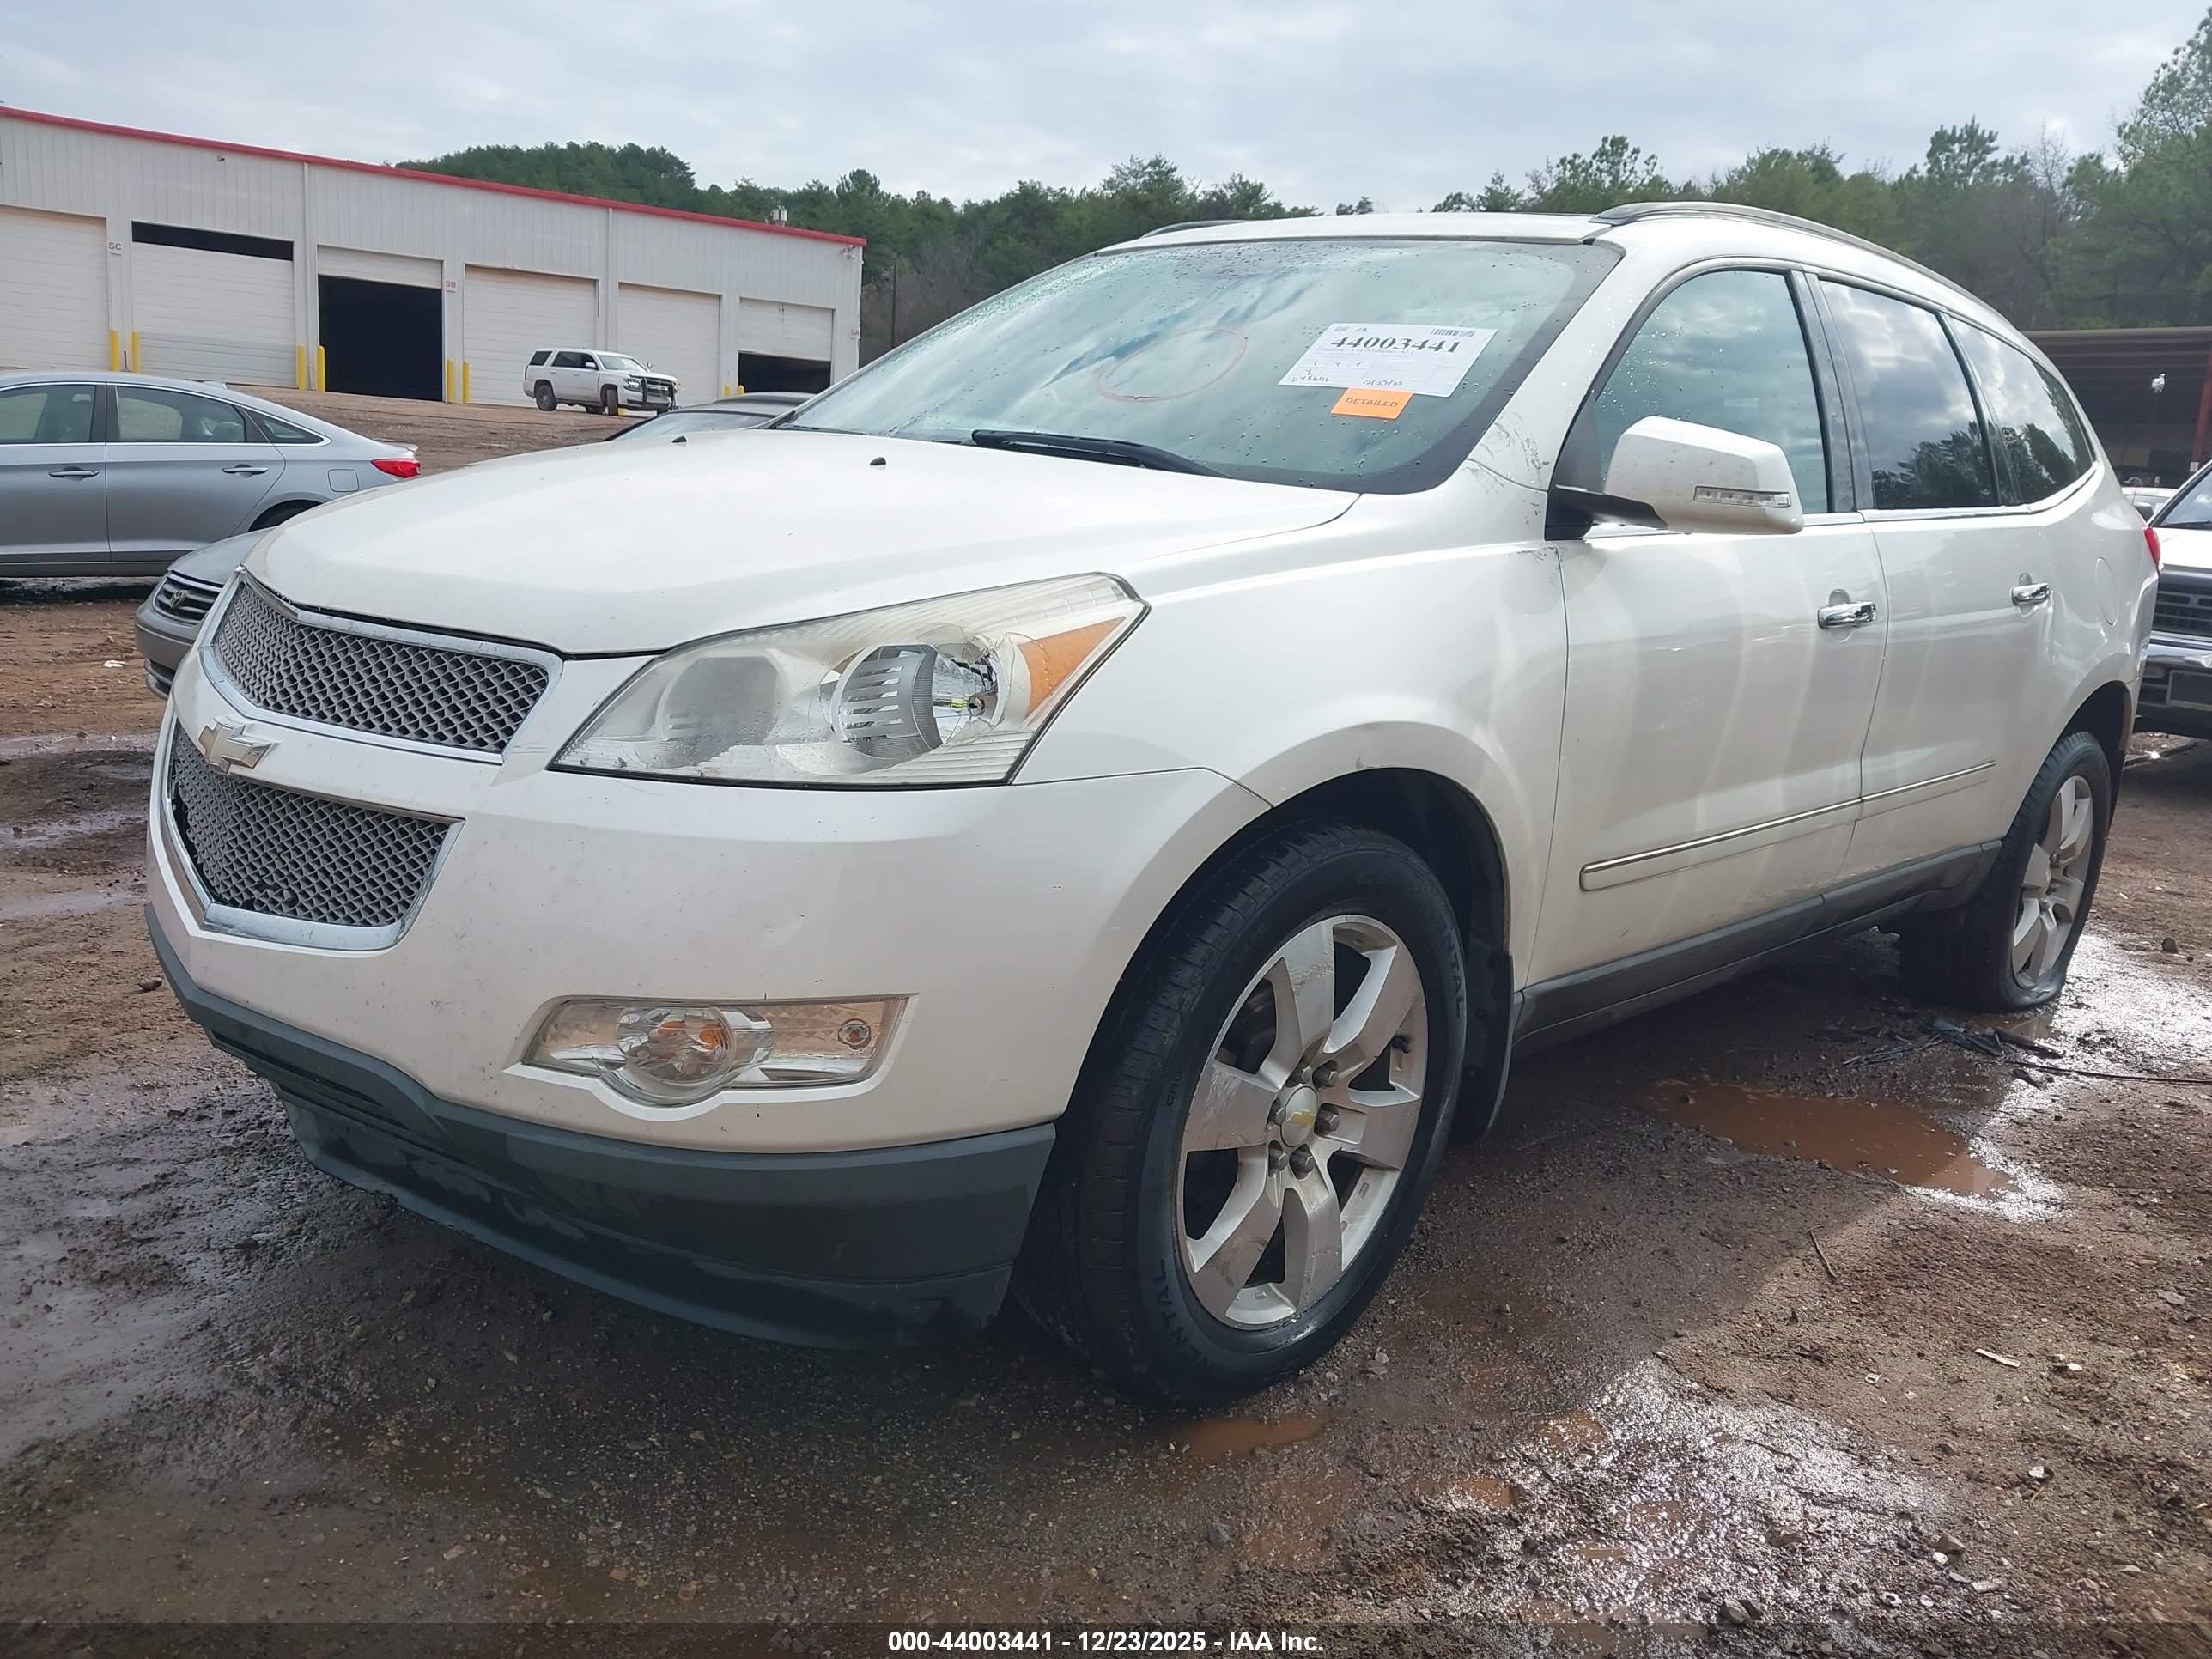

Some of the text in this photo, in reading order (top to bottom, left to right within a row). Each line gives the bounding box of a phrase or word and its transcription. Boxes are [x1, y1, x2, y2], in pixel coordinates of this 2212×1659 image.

[108, 241, 122, 251] SC
[1330, 336, 1462, 354] 44003441
[1344, 397, 1399, 409] DETAILED
